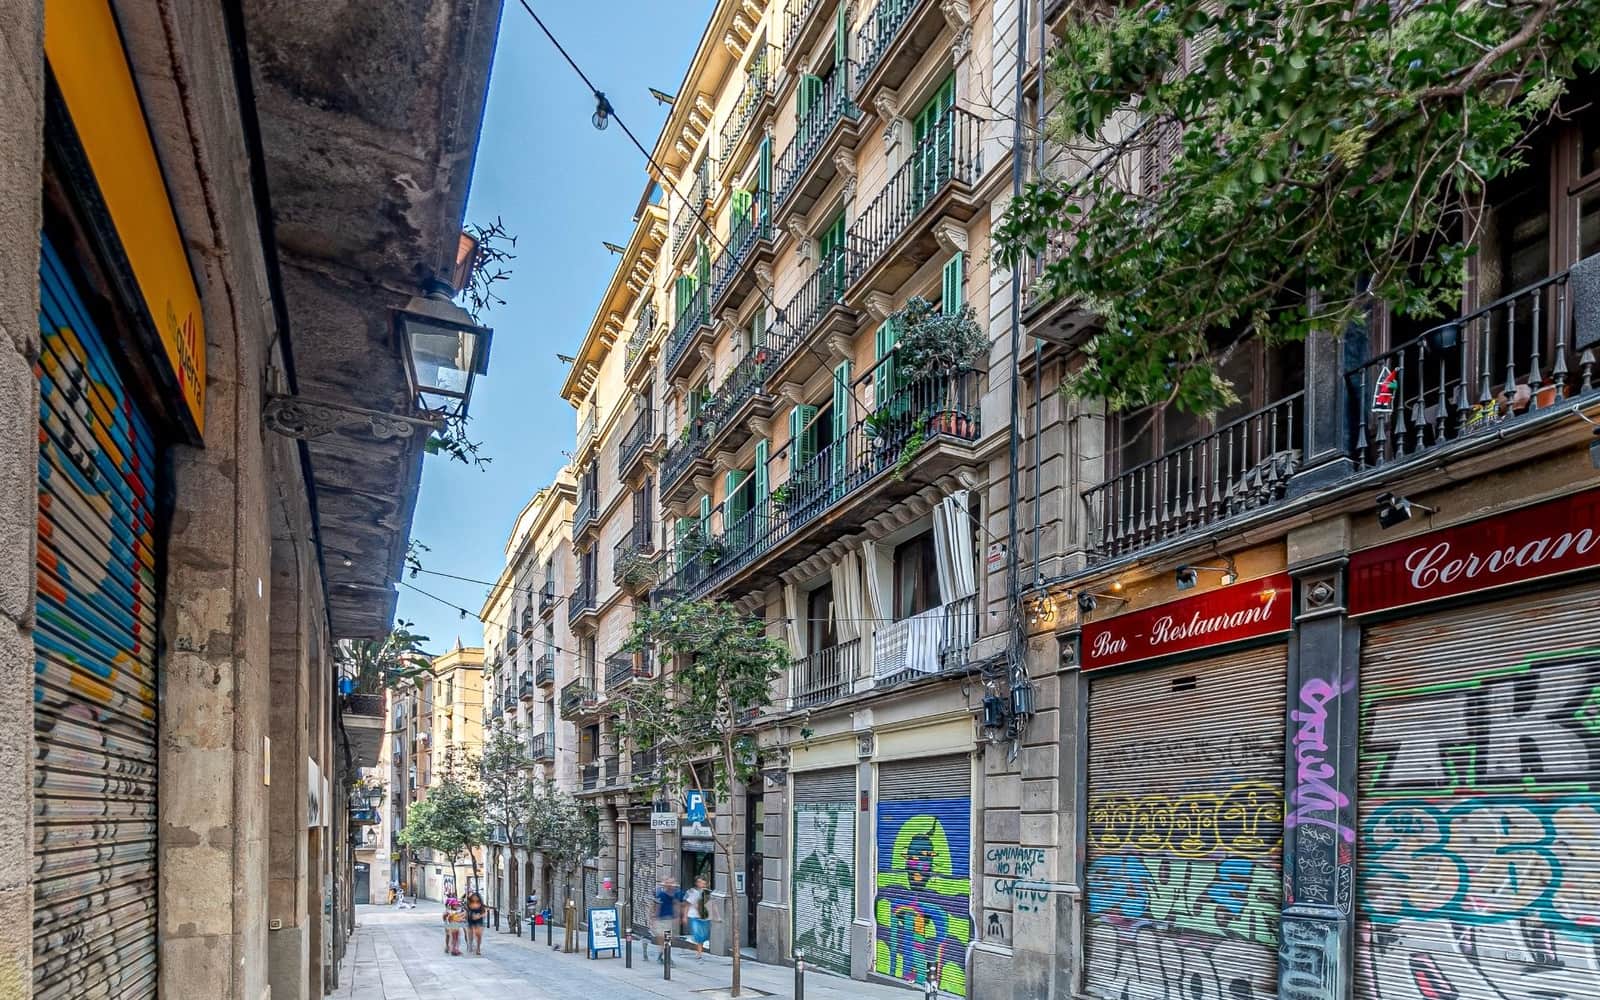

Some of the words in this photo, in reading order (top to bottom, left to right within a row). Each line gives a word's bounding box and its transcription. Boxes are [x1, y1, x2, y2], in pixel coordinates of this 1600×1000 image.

[1405, 528, 1600, 590] Cervan
[1091, 630, 1127, 658] Bar
[1150, 591, 1277, 646] Restaurant
[690, 793, 703, 811] P
[652, 819, 676, 827] BIKES
[987, 847, 1045, 864] CAMINANTE
[997, 862, 1010, 874] NO
[1014, 861, 1034, 877] HAY
